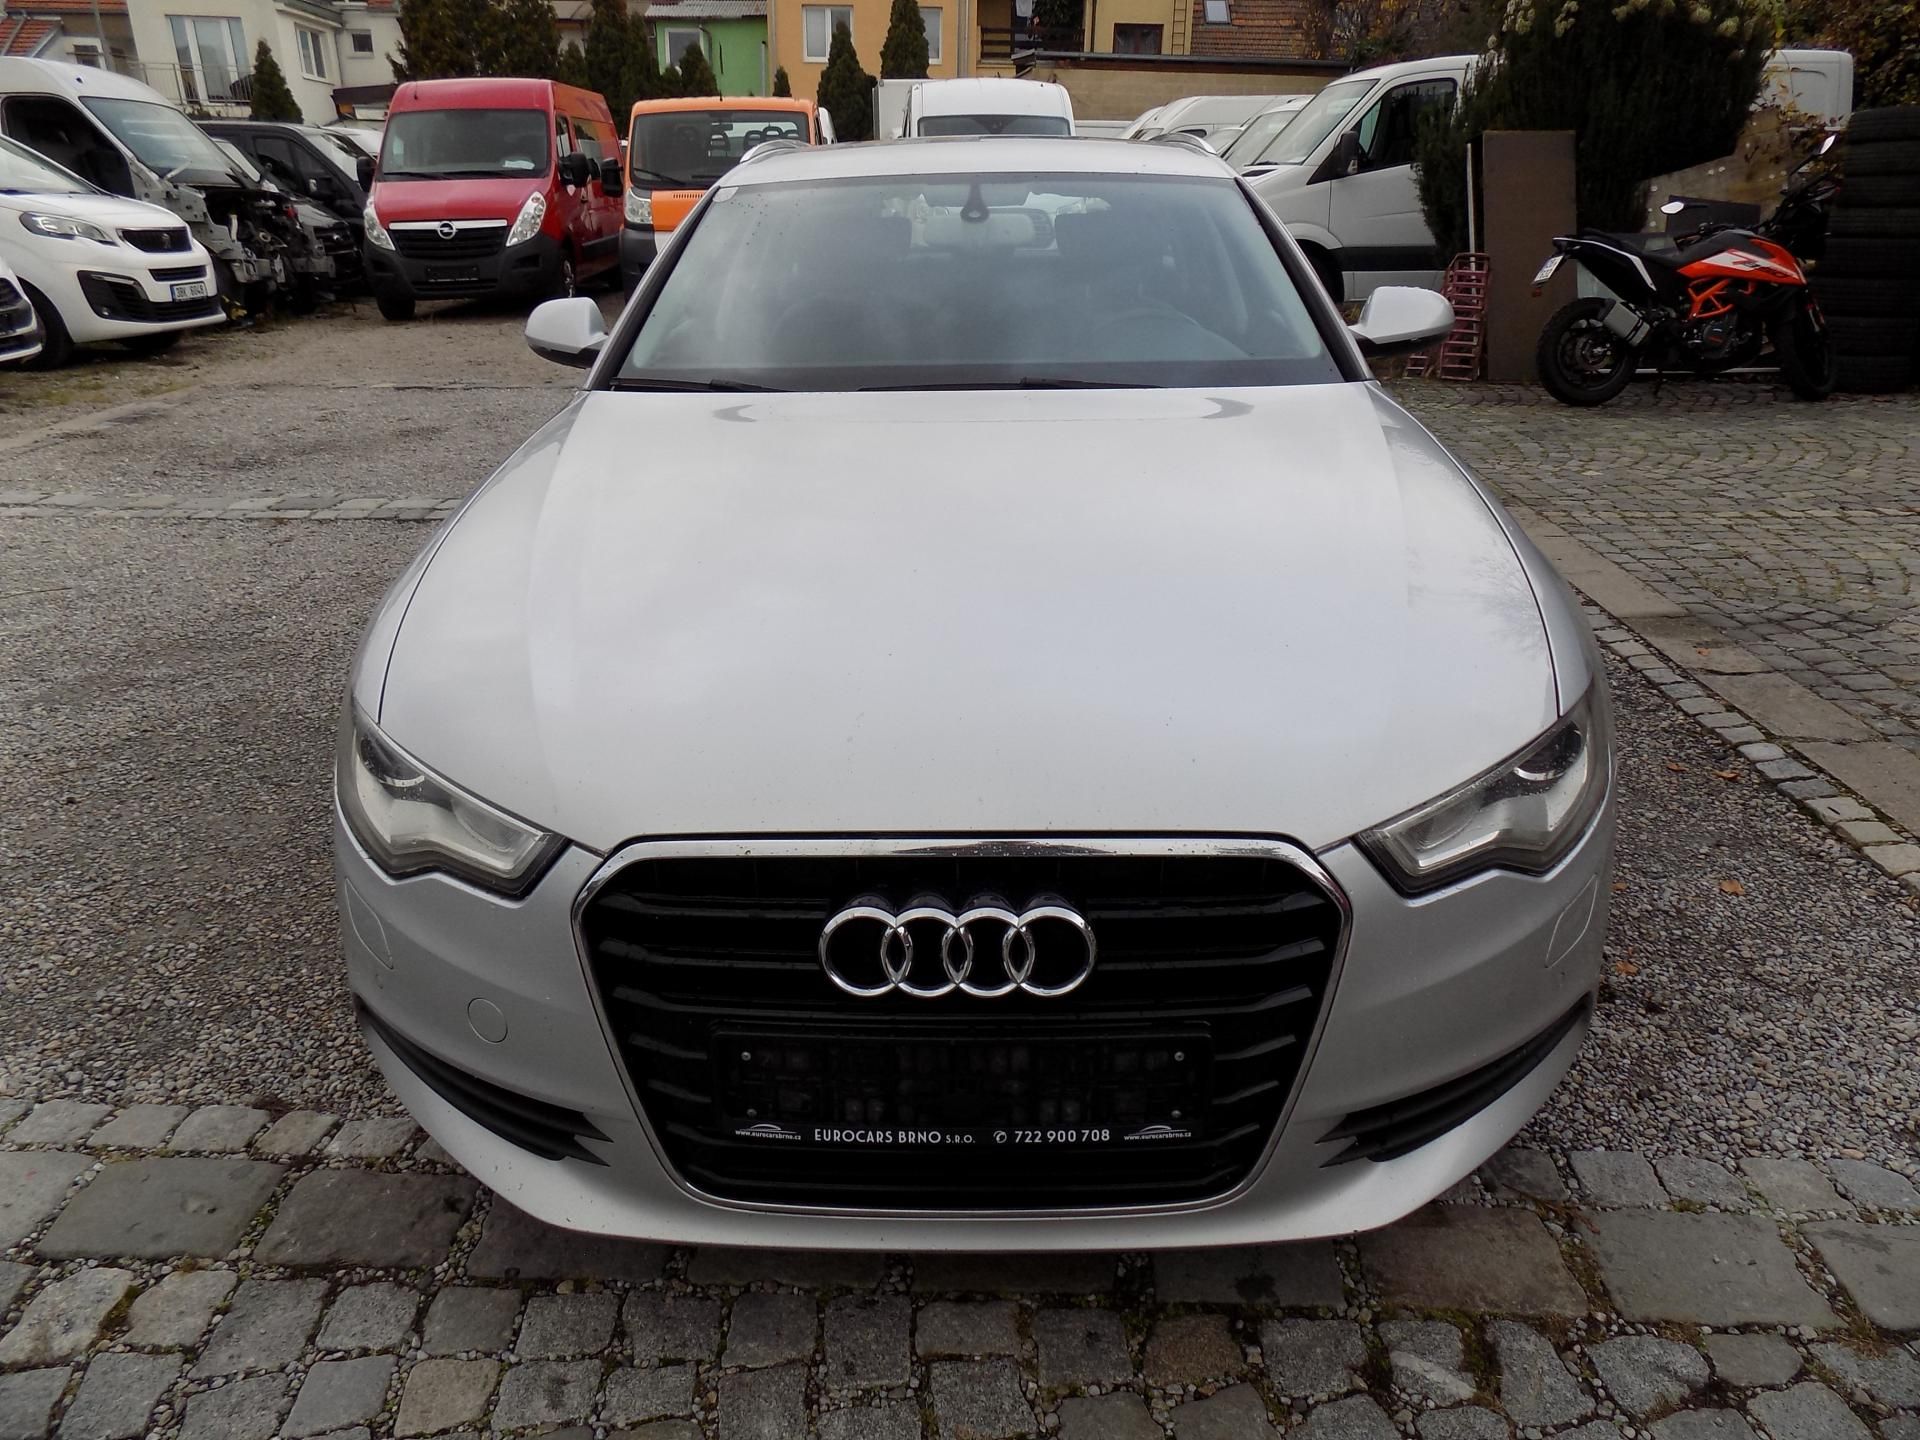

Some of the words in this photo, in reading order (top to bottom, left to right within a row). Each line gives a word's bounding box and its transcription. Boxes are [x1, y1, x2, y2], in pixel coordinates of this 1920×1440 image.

[814, 1128, 893, 1143] EUROCARS
[898, 1130, 942, 1144] BRNO
[1014, 1130, 1042, 1144] 722
[1046, 1130, 1077, 1144] 900
[1081, 1129, 1110, 1142] 708
